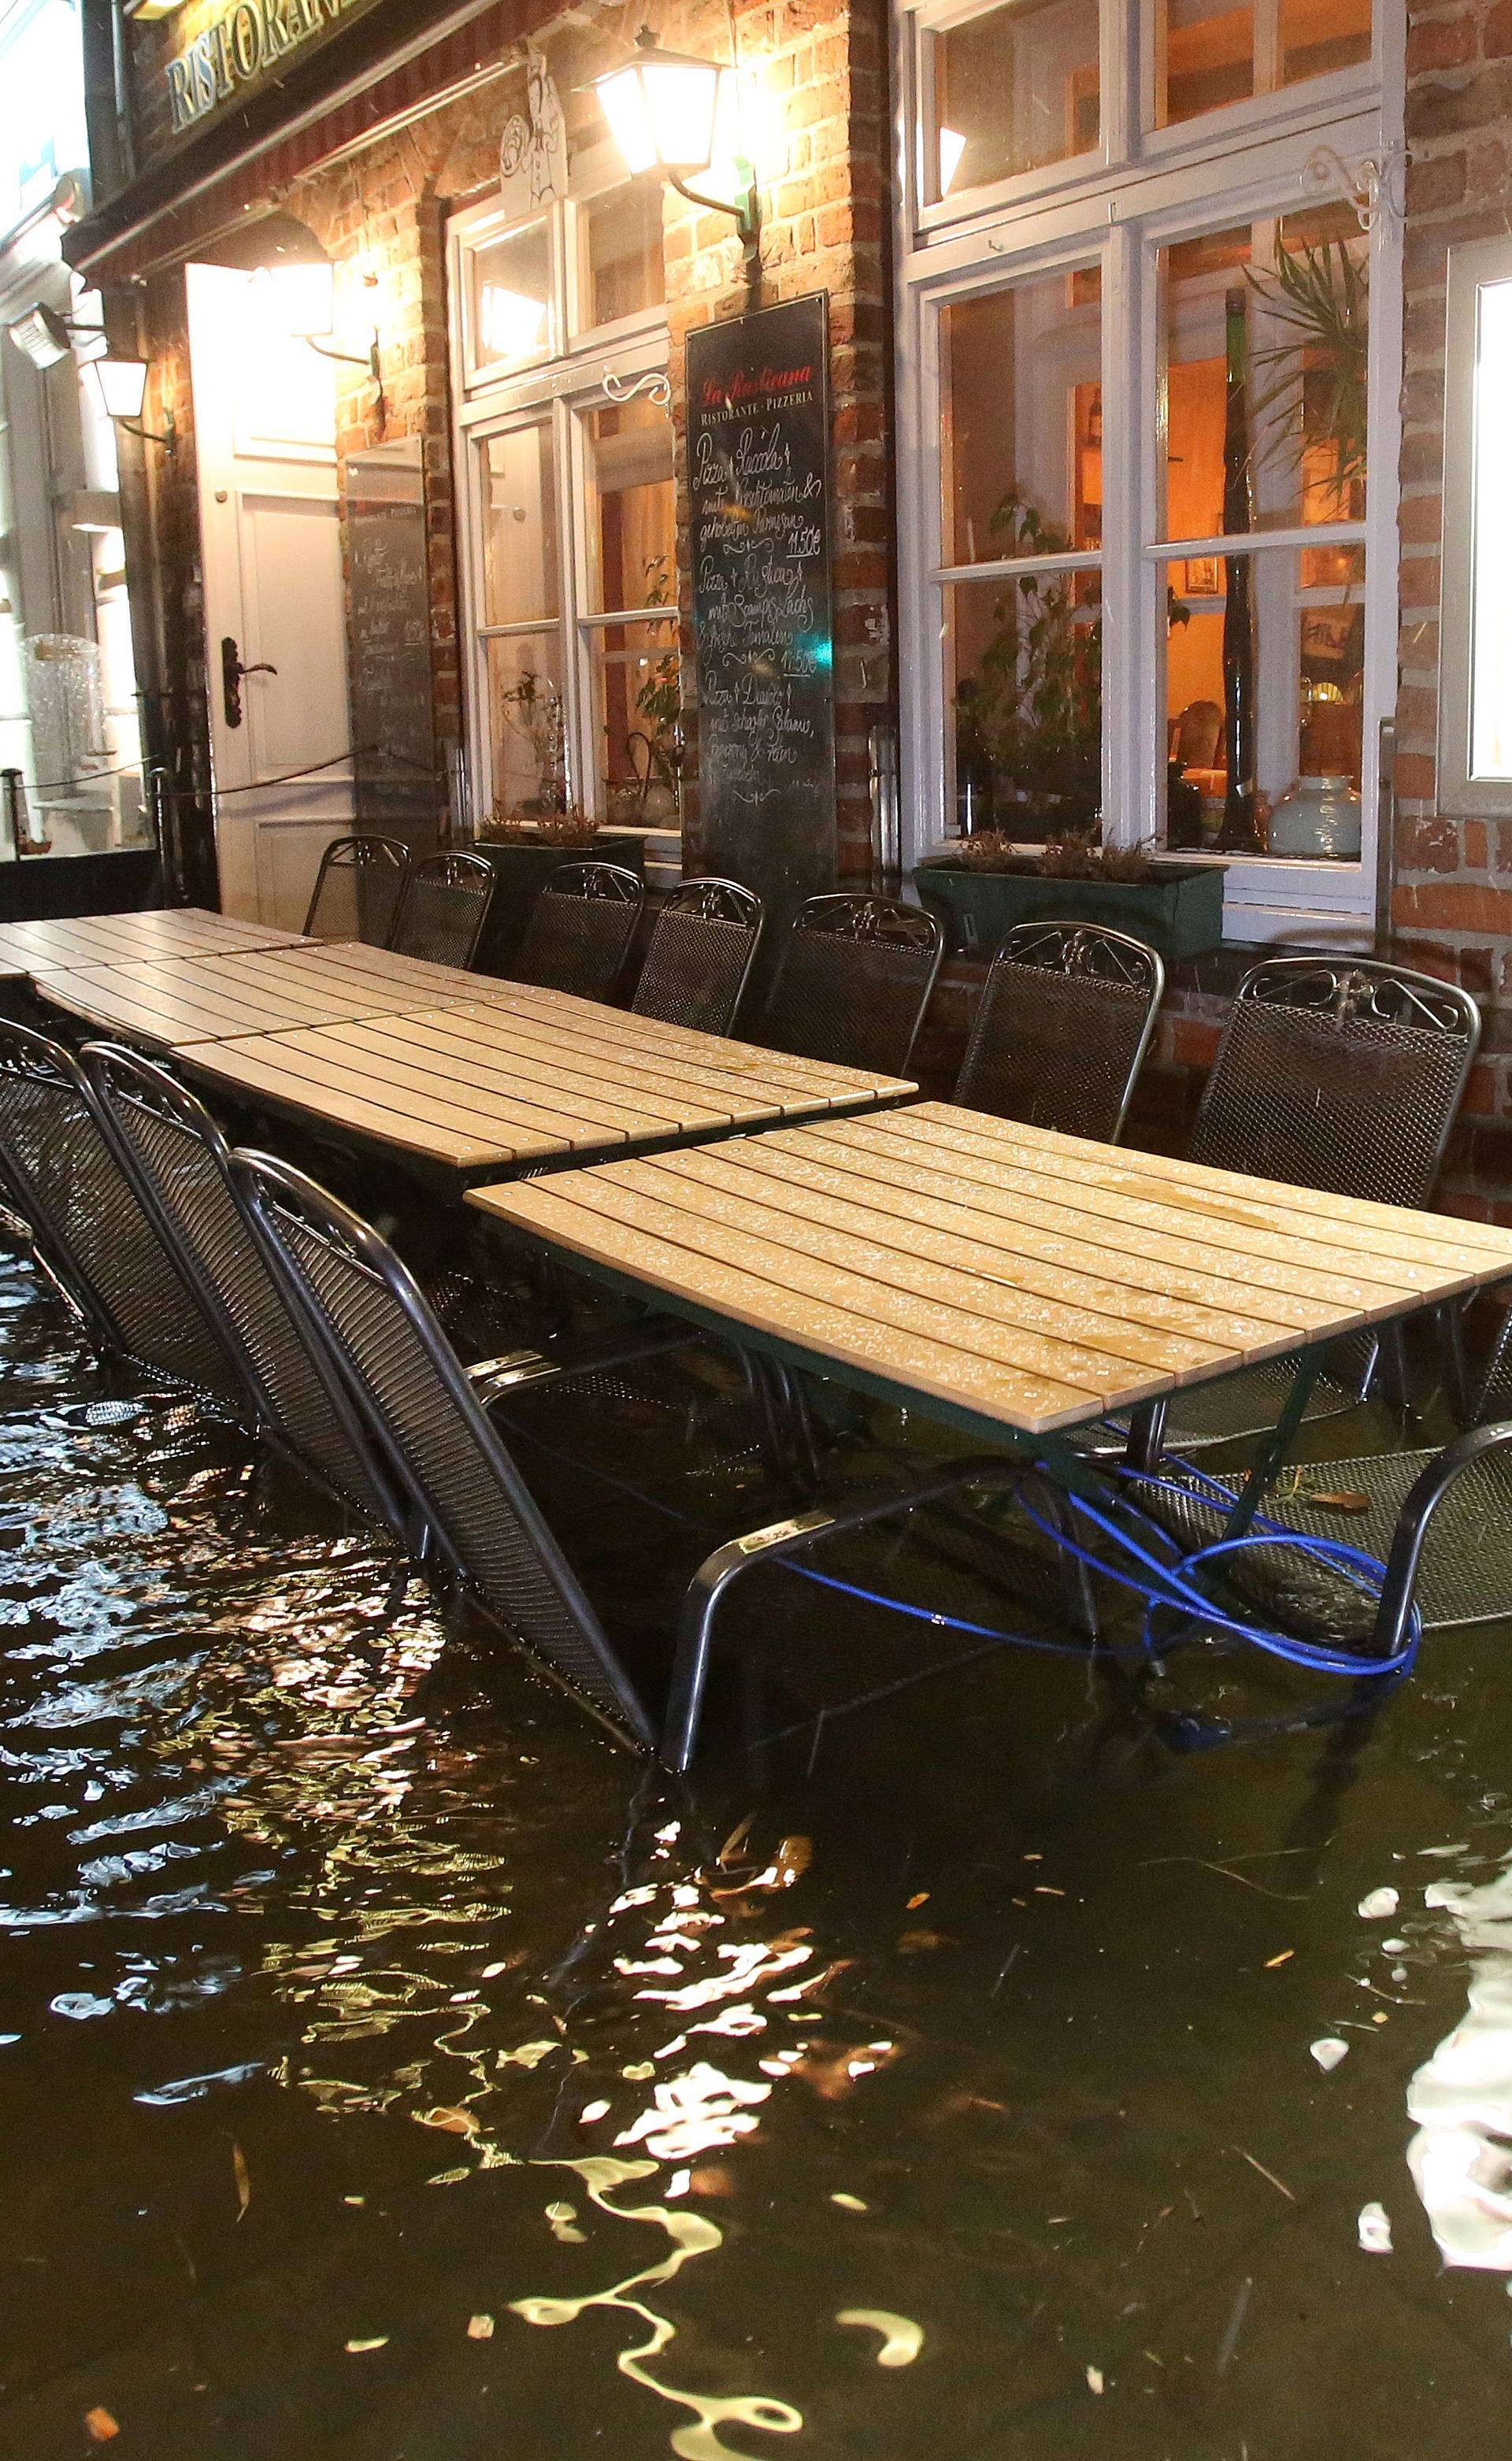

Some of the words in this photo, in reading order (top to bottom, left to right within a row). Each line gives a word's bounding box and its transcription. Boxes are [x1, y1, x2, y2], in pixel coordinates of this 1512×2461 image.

[766, 390, 813, 411] PIZZERIA
[693, 432, 726, 491] Pizza
[699, 555, 728, 593] Pizza
